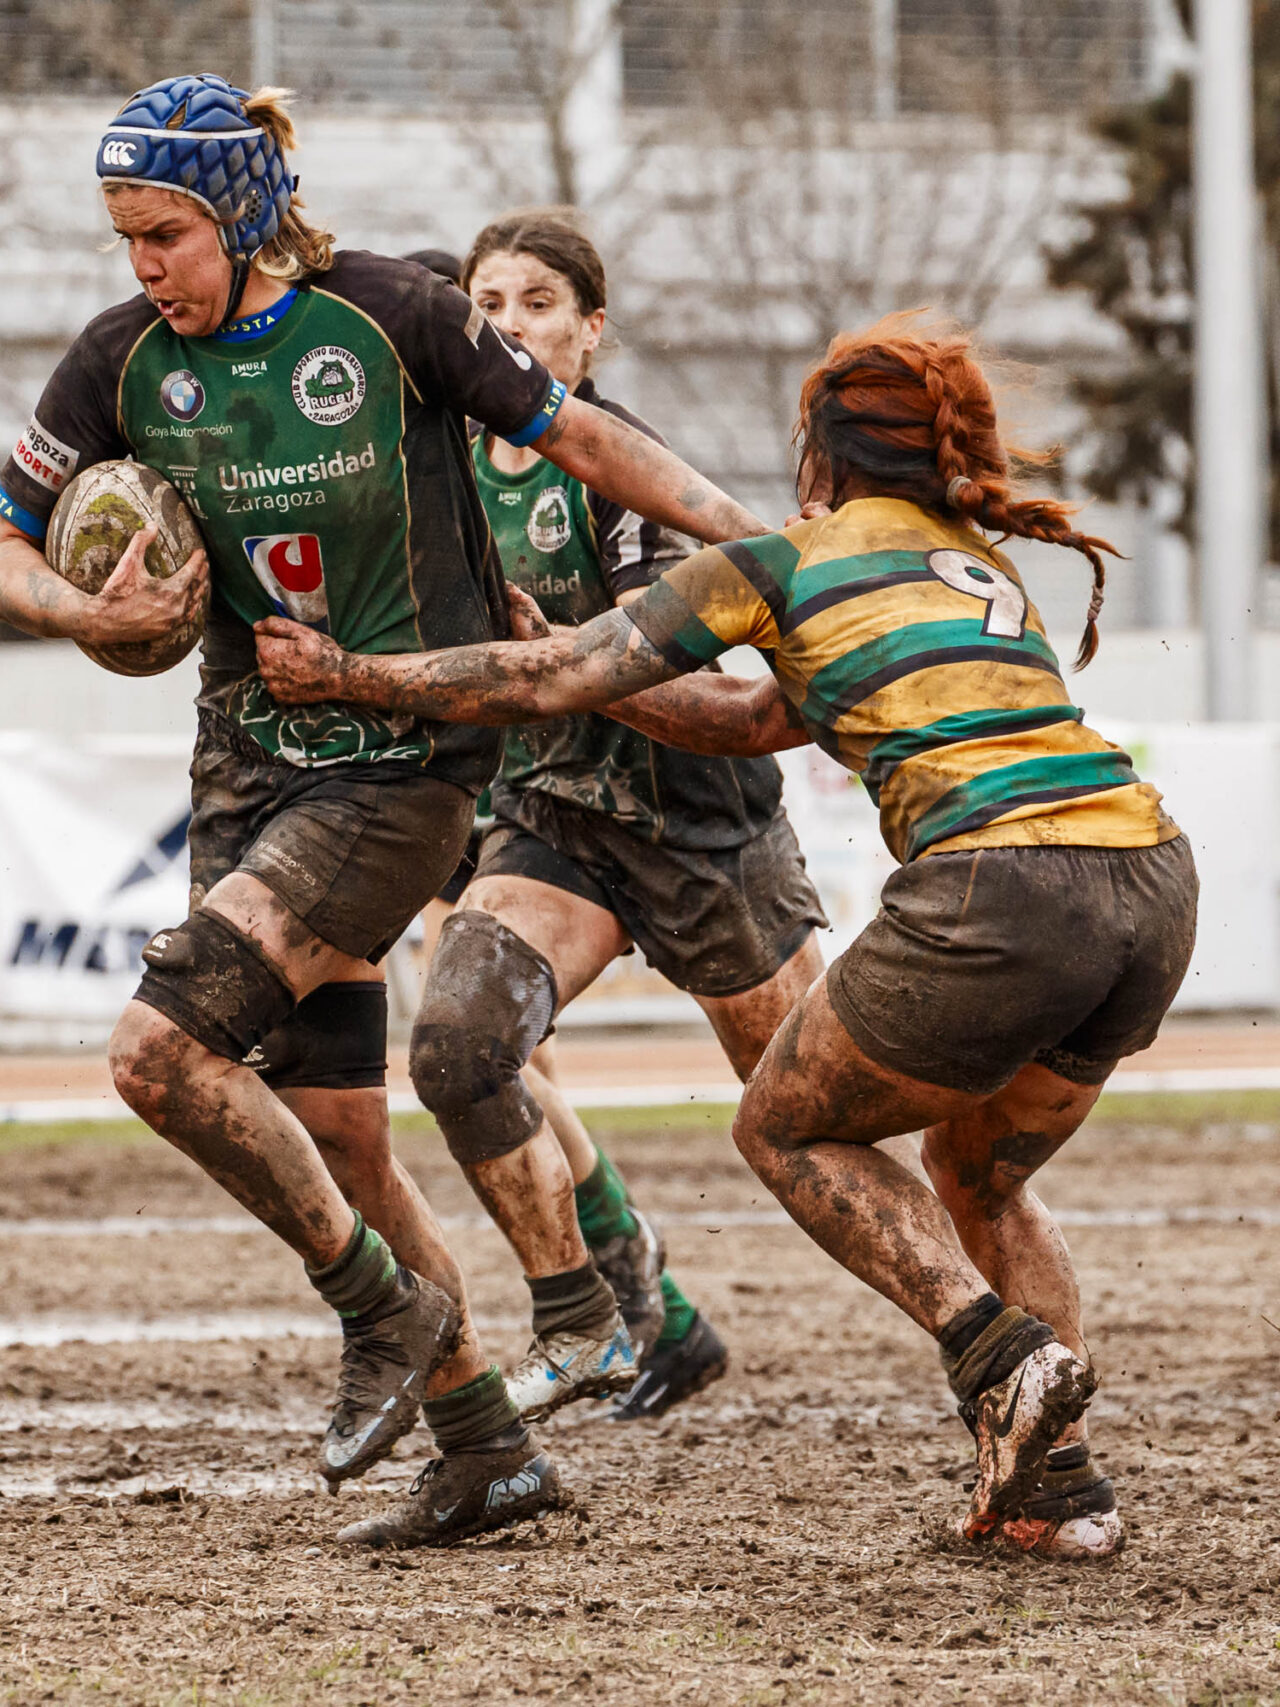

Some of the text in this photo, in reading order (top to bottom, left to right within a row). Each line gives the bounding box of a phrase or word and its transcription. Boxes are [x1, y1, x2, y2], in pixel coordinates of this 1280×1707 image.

[231, 360, 268, 376] AMURA
[293, 347, 327, 382] DEPORTIVO
[328, 347, 365, 397] UNIVERSITARIO
[309, 390, 354, 410] RUGBY
[312, 404, 357, 422] ZARAGOZA
[145, 425, 169, 438] Goya
[218, 441, 376, 491] Universidad
[223, 489, 327, 514] Zaragoza
[923, 548, 1029, 642] 9
